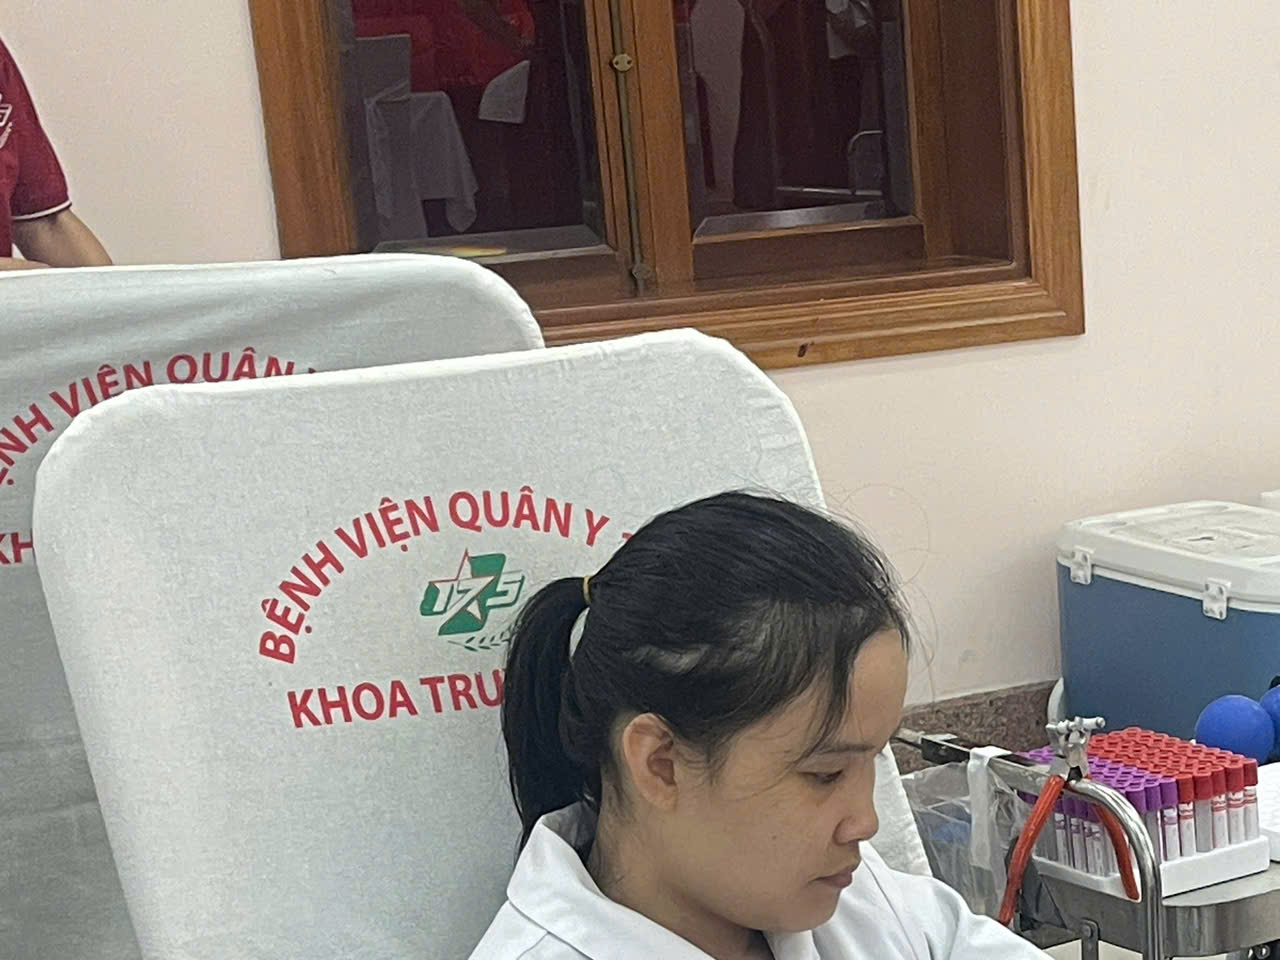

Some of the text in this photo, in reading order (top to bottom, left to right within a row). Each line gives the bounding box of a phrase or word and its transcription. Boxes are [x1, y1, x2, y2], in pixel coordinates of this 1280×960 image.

[258, 485, 610, 664] BỆNH VIỆN QUÂN Y
[287, 668, 504, 729] KHOA TRU
